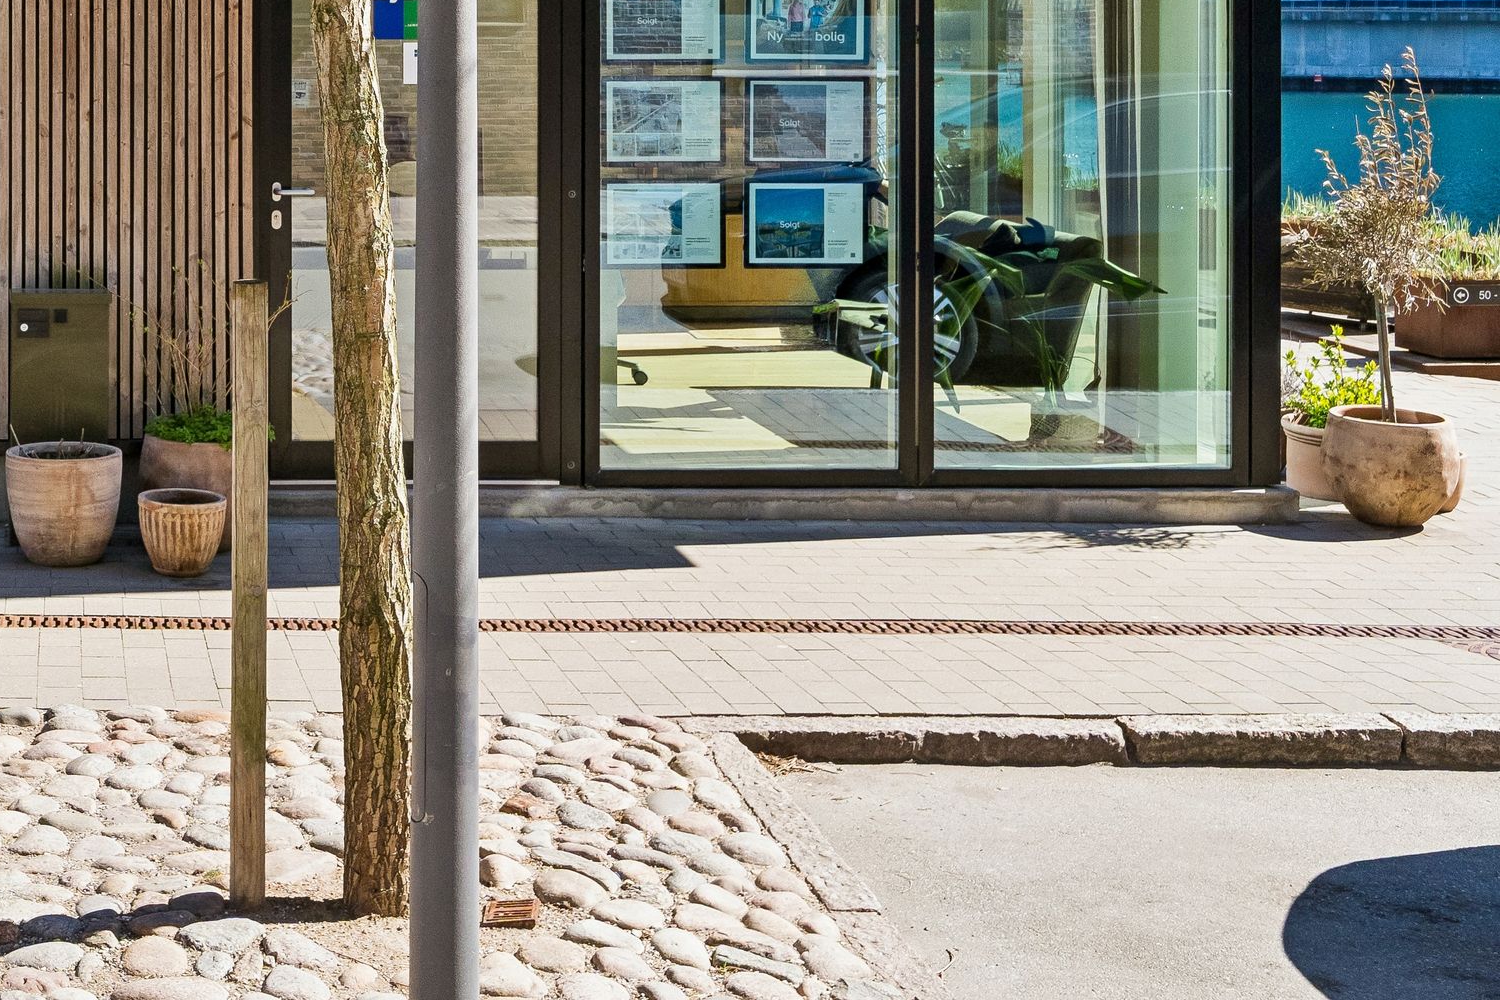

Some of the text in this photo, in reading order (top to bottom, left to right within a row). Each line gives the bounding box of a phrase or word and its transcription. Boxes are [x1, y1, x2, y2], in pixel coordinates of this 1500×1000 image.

[637, 16, 658, 26] Solgt
[767, 31, 784, 43] Ny
[815, 31, 845, 44] bolig
[779, 119, 801, 128] Solgt
[779, 220, 801, 230] Solgt
[1478, 290, 1492, 300] 50
